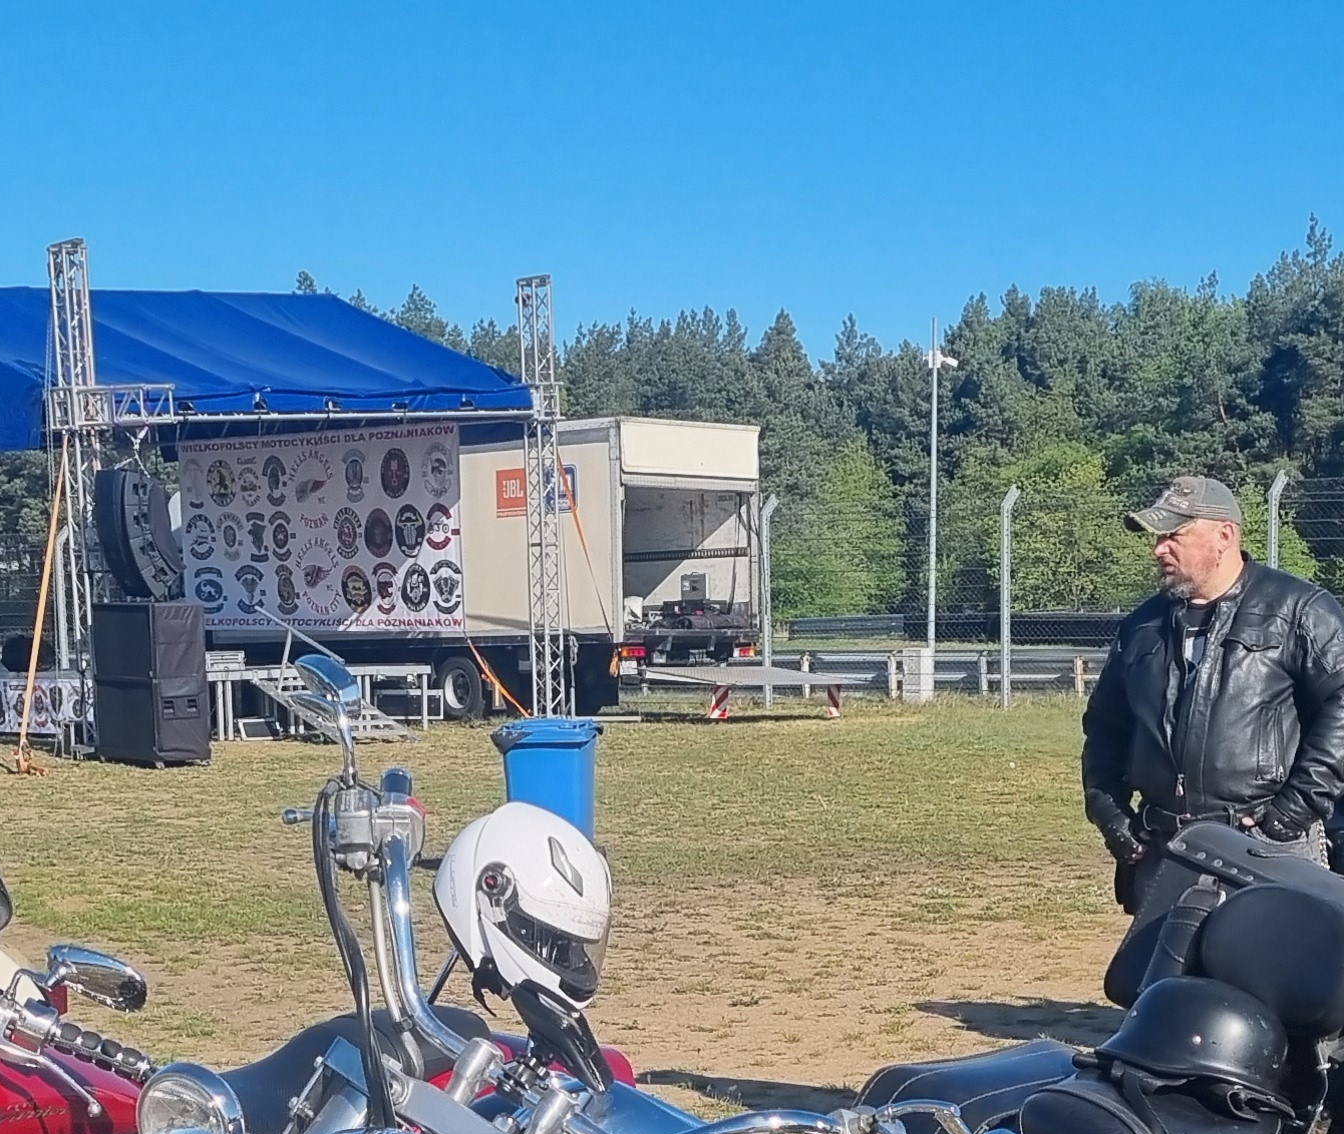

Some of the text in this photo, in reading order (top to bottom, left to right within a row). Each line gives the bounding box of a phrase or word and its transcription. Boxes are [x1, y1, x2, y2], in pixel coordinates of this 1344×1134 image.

[181, 440, 258, 453] WIELKOPOLSCY
[344, 432, 365, 443] DLA
[502, 479, 524, 499] JBL
